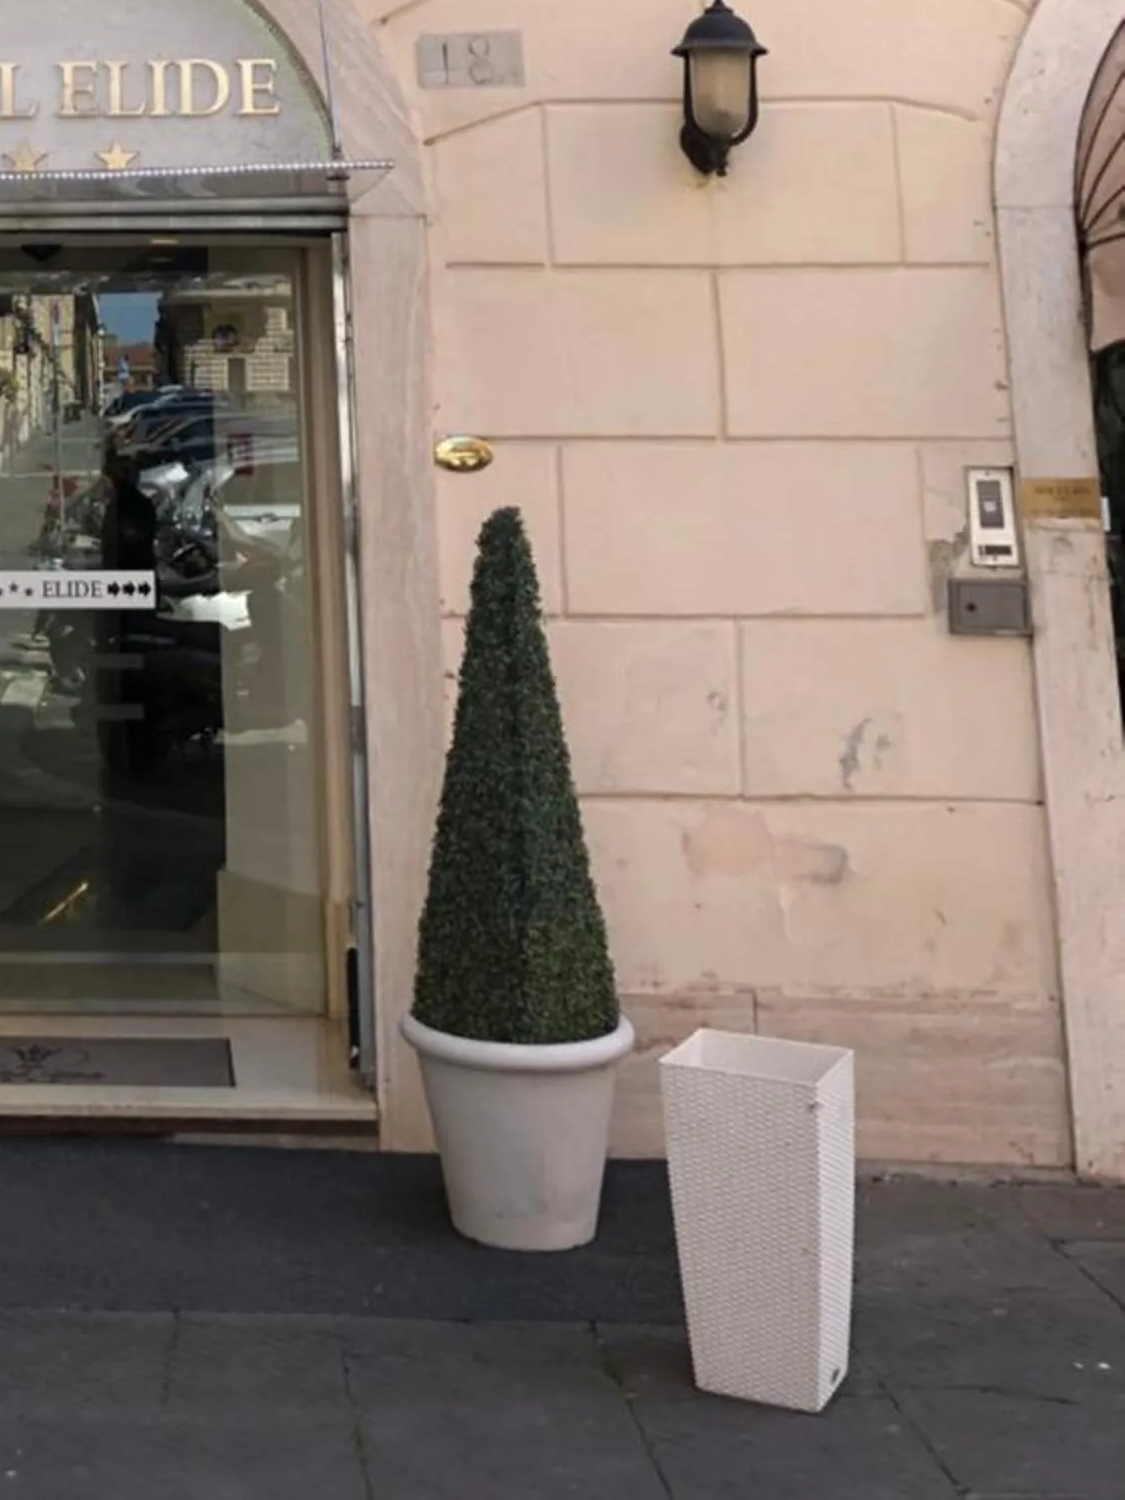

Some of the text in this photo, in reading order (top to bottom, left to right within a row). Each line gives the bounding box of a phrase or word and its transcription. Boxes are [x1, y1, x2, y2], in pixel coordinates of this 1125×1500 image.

[440, 35, 493, 85] 18
[57, 57, 282, 120] ELIDE
[42, 579, 104, 598] ELIDE
